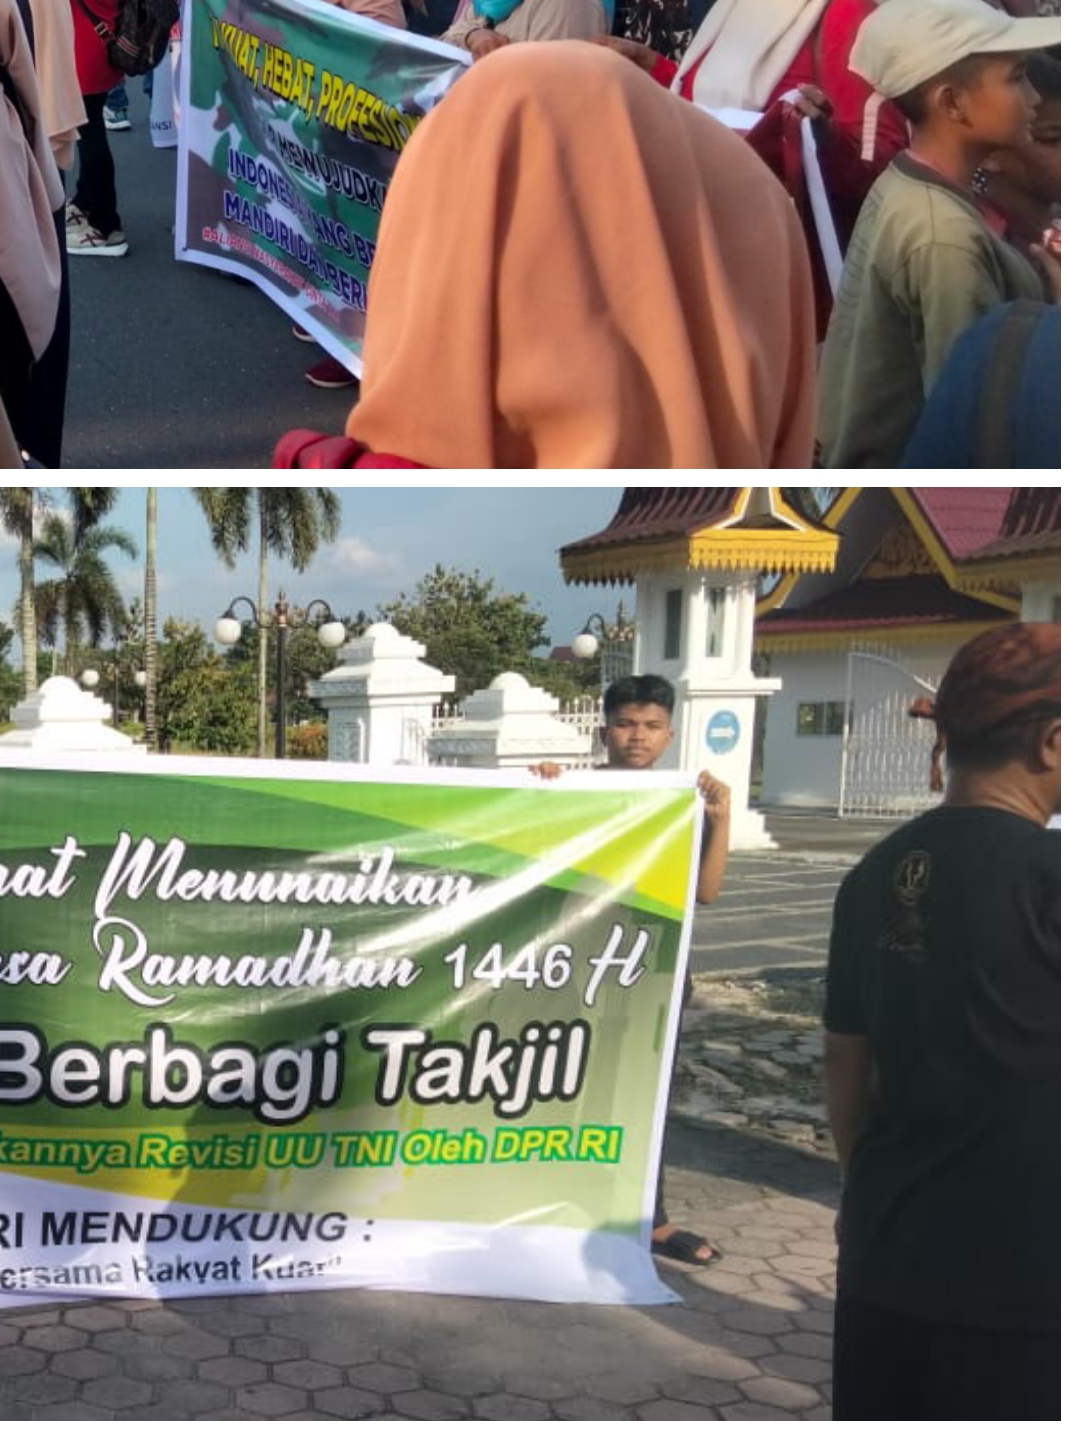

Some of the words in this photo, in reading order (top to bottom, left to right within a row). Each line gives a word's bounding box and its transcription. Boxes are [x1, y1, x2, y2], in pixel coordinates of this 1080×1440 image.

[261, 42, 315, 124] HEBAT,
[278, 136, 388, 212] MEWUJUDK
[224, 190, 297, 255] MANDIRI
[94, 832, 477, 922] Menunaikan
[92, 915, 422, 1008] Ramadhan
[443, 942, 573, 989] 1446
[588, 924, 650, 1007] H
[364, 1023, 588, 1115] Takjil
[139, 1135, 255, 1169] Revisi
[267, 1133, 321, 1165] UU
[332, 1133, 395, 1166] TNI
[403, 1130, 483, 1164] Oleh
[493, 1129, 570, 1162] DPR
[580, 1126, 622, 1162] RI
[40, 1211, 347, 1247] MENDUKUNG
[362, 1219, 375, 1242] :
[134, 1254, 241, 1287] Rakyat
